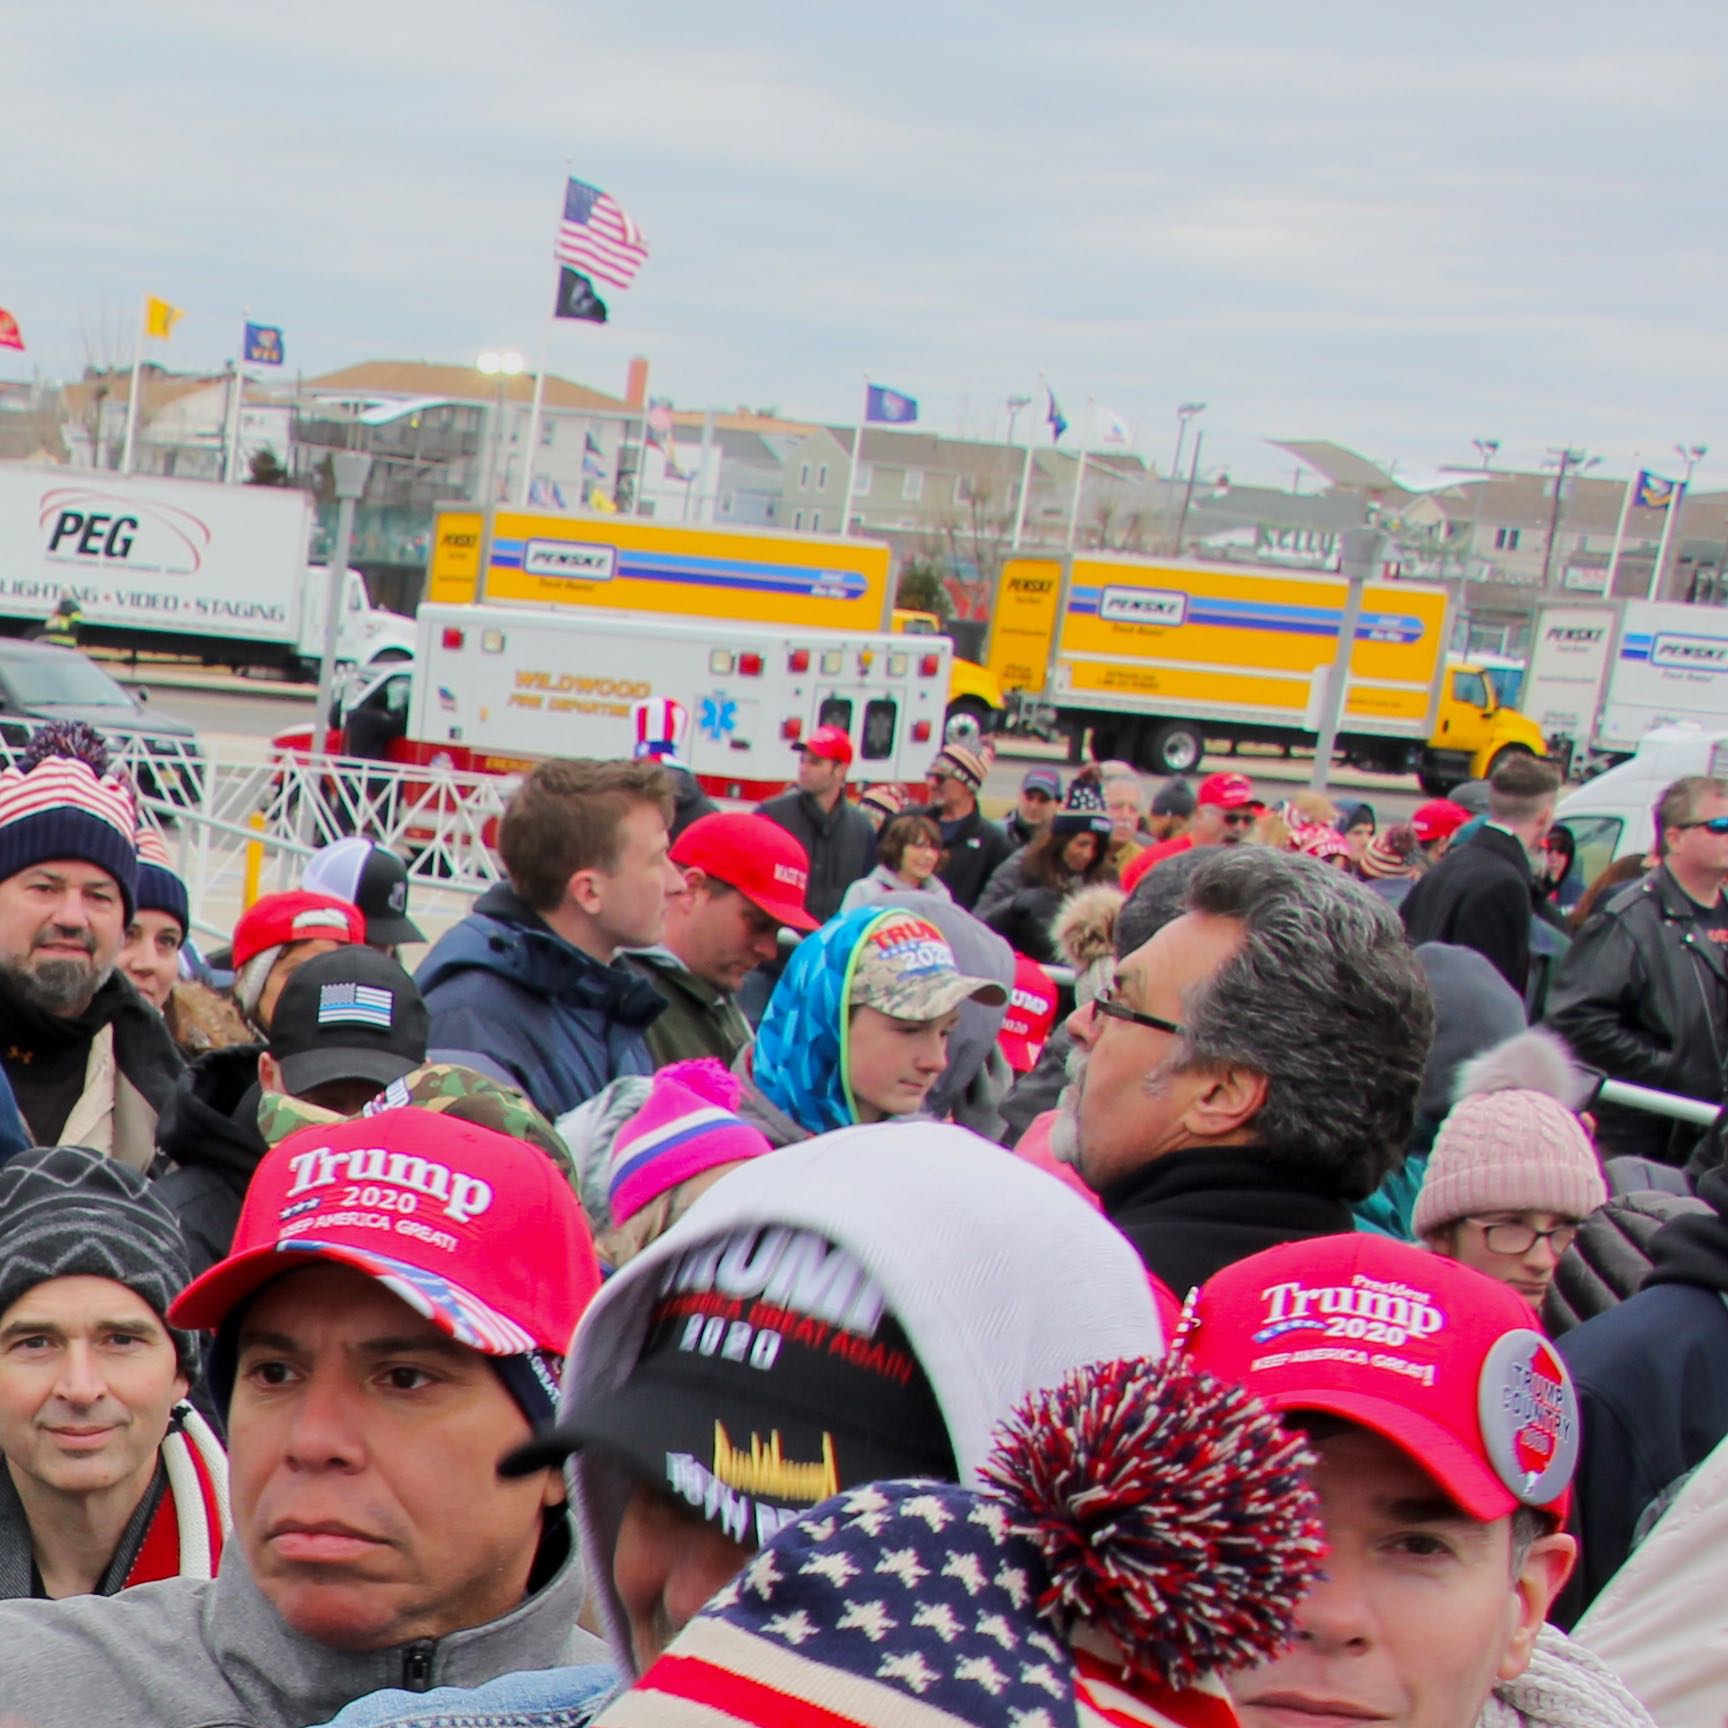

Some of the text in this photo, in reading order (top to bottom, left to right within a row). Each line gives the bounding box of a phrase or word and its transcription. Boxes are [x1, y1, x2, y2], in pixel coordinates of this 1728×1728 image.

[48, 510, 140, 560] PEG
[530, 549, 609, 571] PENSKE
[1007, 577, 1054, 595] PENSKE
[113, 589, 179, 613] VIDEO
[194, 598, 287, 625] STAGING
[1107, 598, 1179, 616] PENSKE
[1545, 627, 1603, 645] PENSKE
[1657, 643, 1728, 663] PENSKE
[514, 668, 653, 700] WILDWOOD
[545, 697, 631, 719] DEPARTME
[899, 943, 955, 971] 202
[1010, 988, 1049, 1016] UMP
[1001, 1017, 1030, 1036] 020
[286, 1140, 492, 1224] Trump
[339, 1185, 418, 1215] 2020
[313, 1211, 391, 1231] AMERICA
[394, 1218, 459, 1252] GREAT!
[1351, 1273, 1432, 1304] President
[1261, 1281, 1444, 1338] Trump
[678, 1311, 783, 1372] 2020
[1324, 1316, 1407, 1347] 2020
[827, 1327, 915, 1386] AGAIN
[1289, 1347, 1369, 1366] AMERICA
[1512, 1362, 1564, 1406] TRUMP
[1502, 1382, 1570, 1444] COUNTRY
